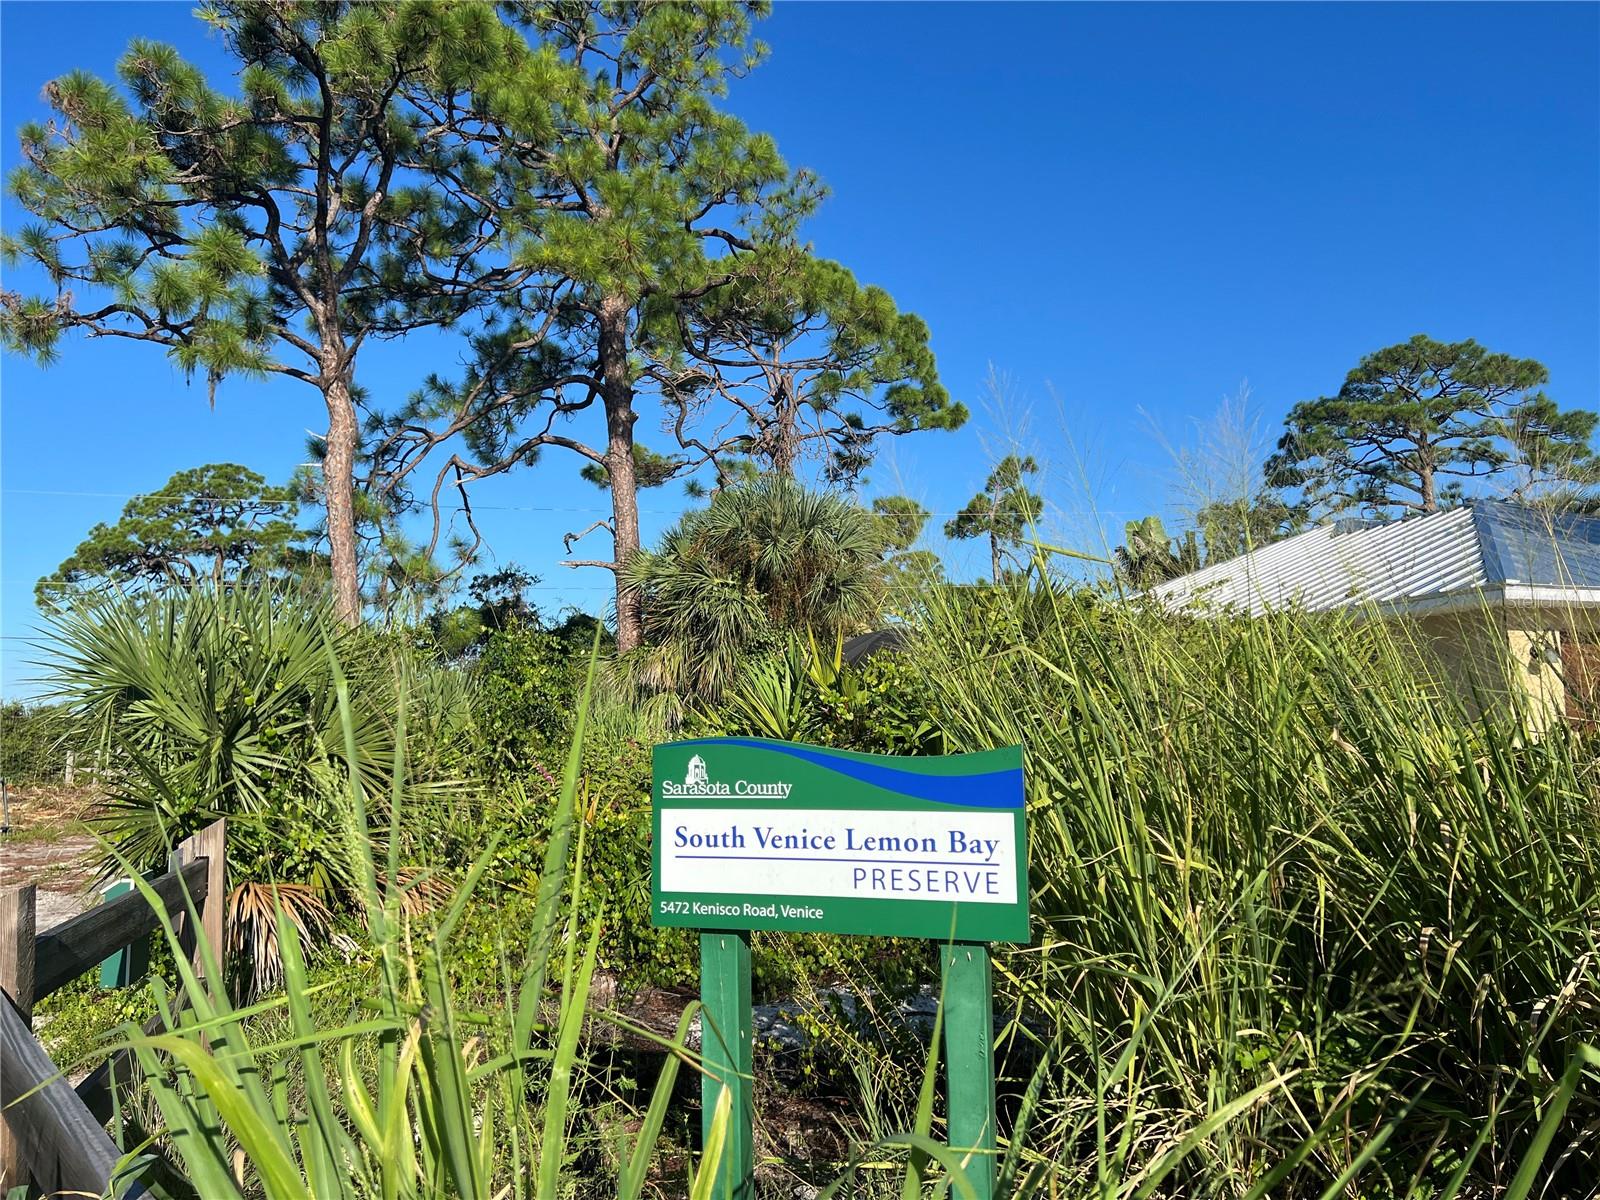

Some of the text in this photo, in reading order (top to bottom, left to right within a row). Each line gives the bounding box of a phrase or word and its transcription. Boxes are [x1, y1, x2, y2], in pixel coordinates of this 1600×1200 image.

[662, 780, 793, 799] Sarasota County
[674, 825, 1000, 862] South Venice Lemon Bay
[853, 867, 999, 894] PRESERVE
[660, 901, 824, 919] 5472 Kenisco Road, Venice
